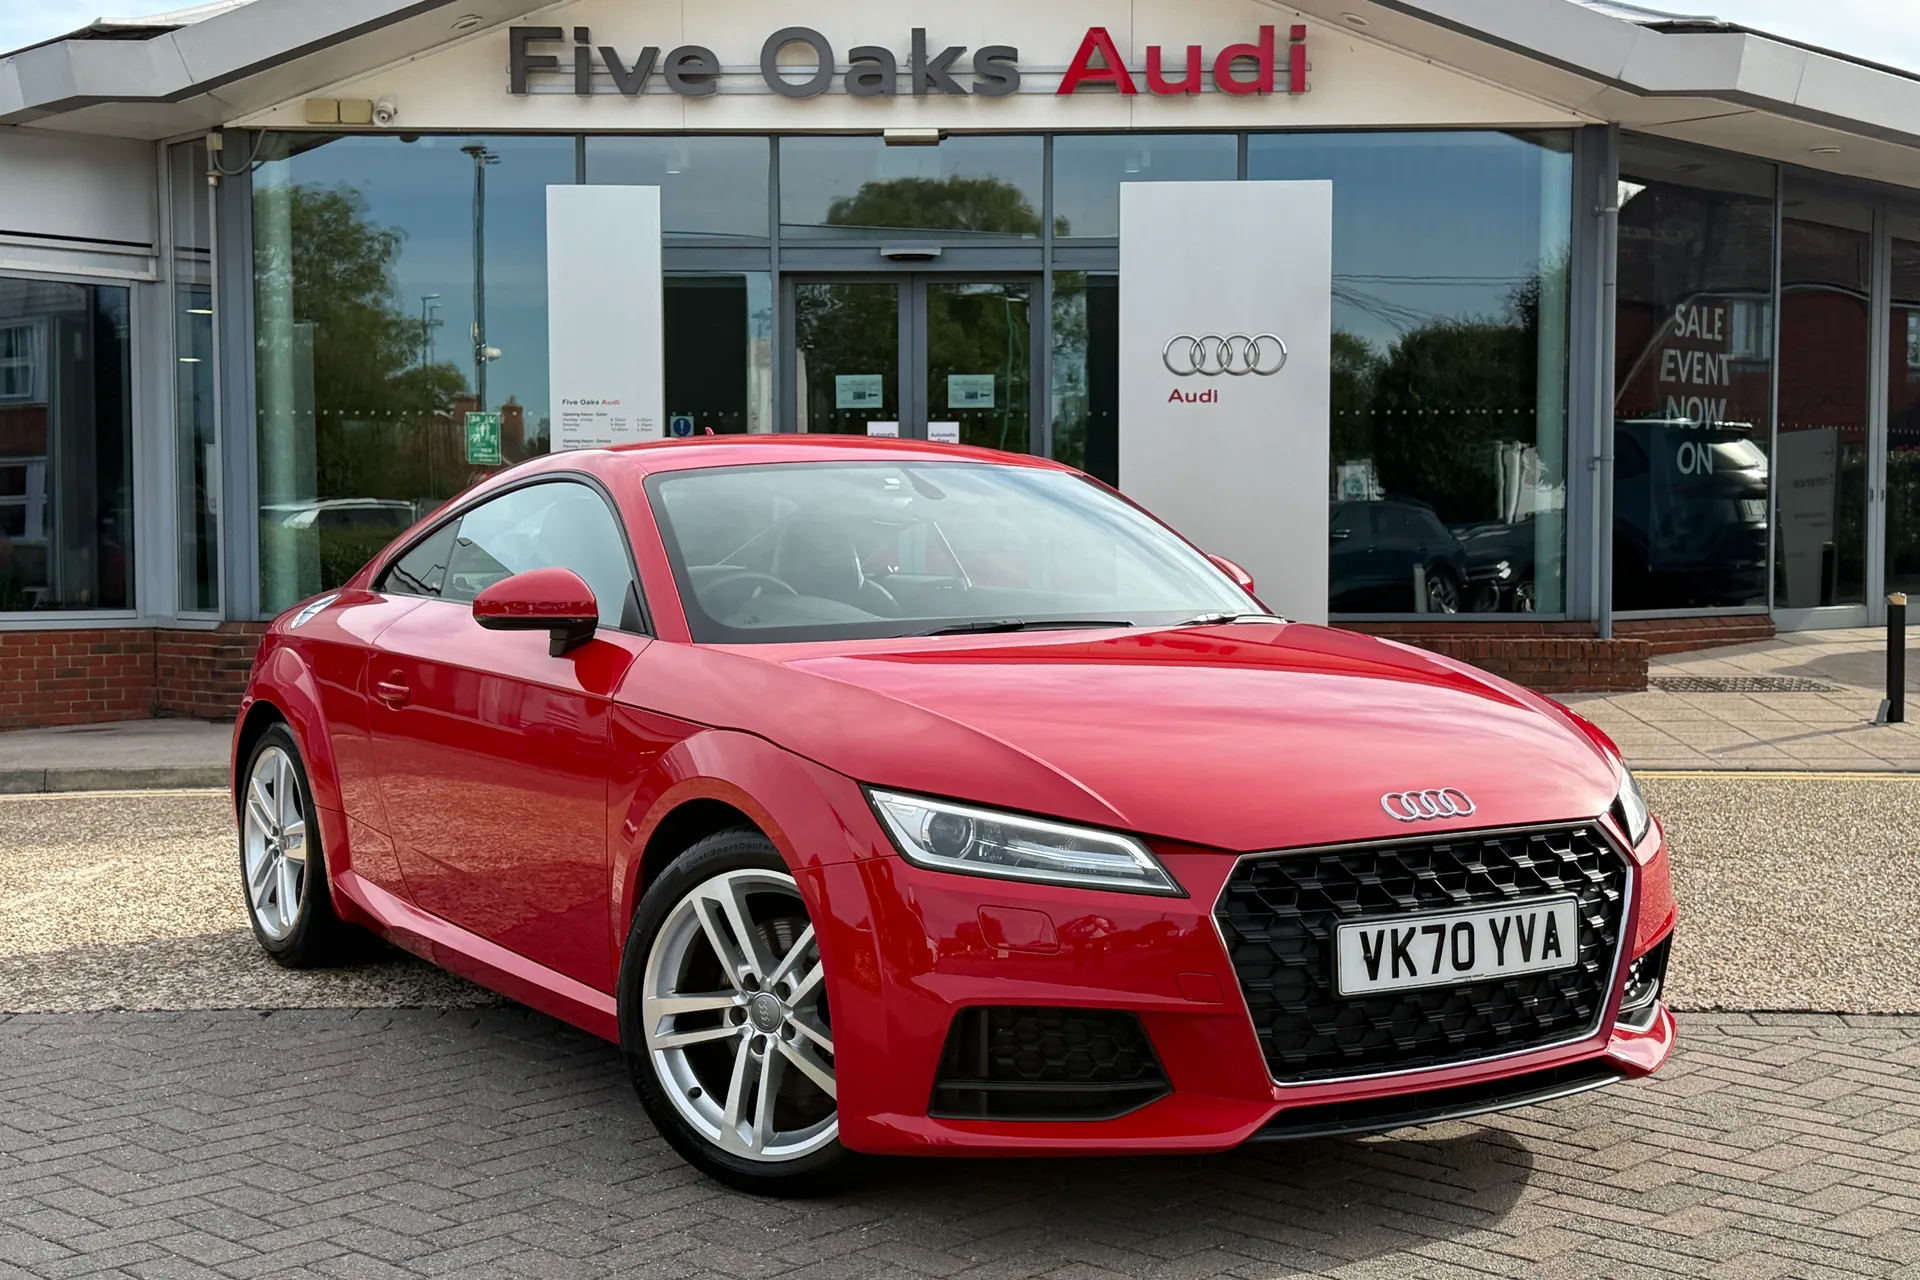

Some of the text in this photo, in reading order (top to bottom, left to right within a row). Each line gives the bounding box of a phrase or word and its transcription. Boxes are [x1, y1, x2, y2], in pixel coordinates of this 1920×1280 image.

[509, 24, 1309, 99] Five Oaks Audi
[1674, 303, 1724, 341] SALE
[1659, 348, 1735, 386] EVENT
[1168, 389, 1219, 403] Audi
[1664, 394, 1727, 431] NOW
[1676, 440, 1714, 476] ON
[1360, 911, 1563, 981] VK70 YVA
